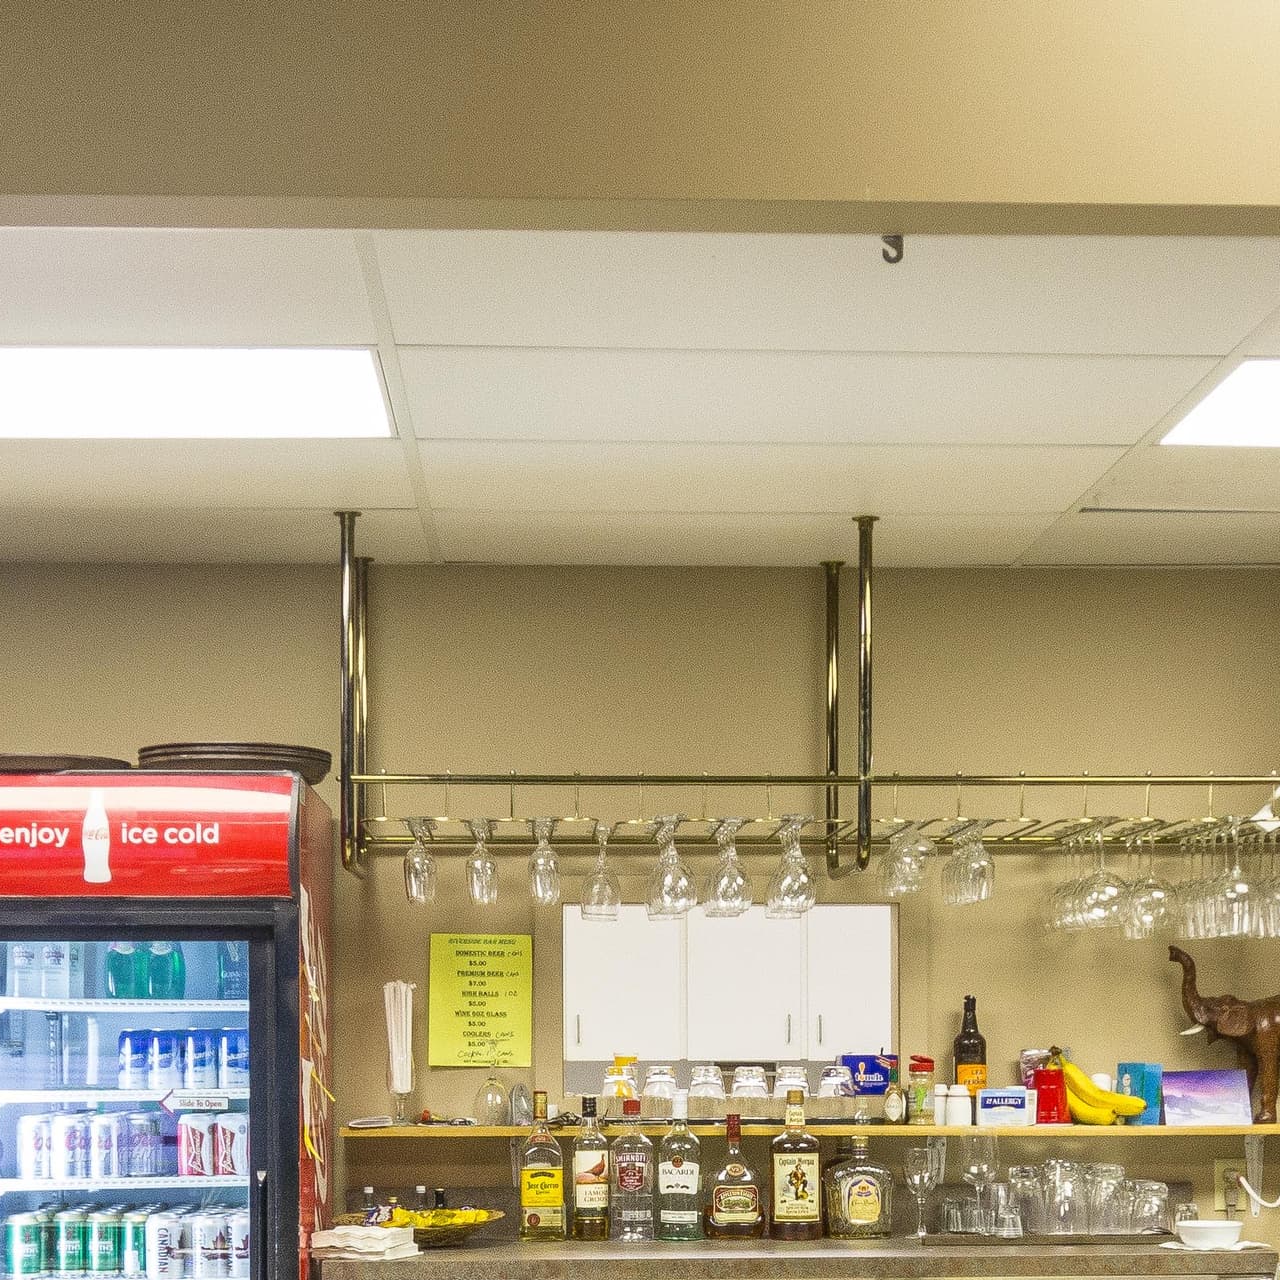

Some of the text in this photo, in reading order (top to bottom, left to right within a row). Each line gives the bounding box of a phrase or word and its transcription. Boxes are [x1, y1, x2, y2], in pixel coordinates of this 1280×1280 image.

[121, 822, 158, 844] ice
[164, 822, 219, 844] cold
[179, 1098, 222, 1109] Slide To Open
[662, 1168, 695, 1176] BACARDI
[157, 1227, 169, 1274] CANADIAN
